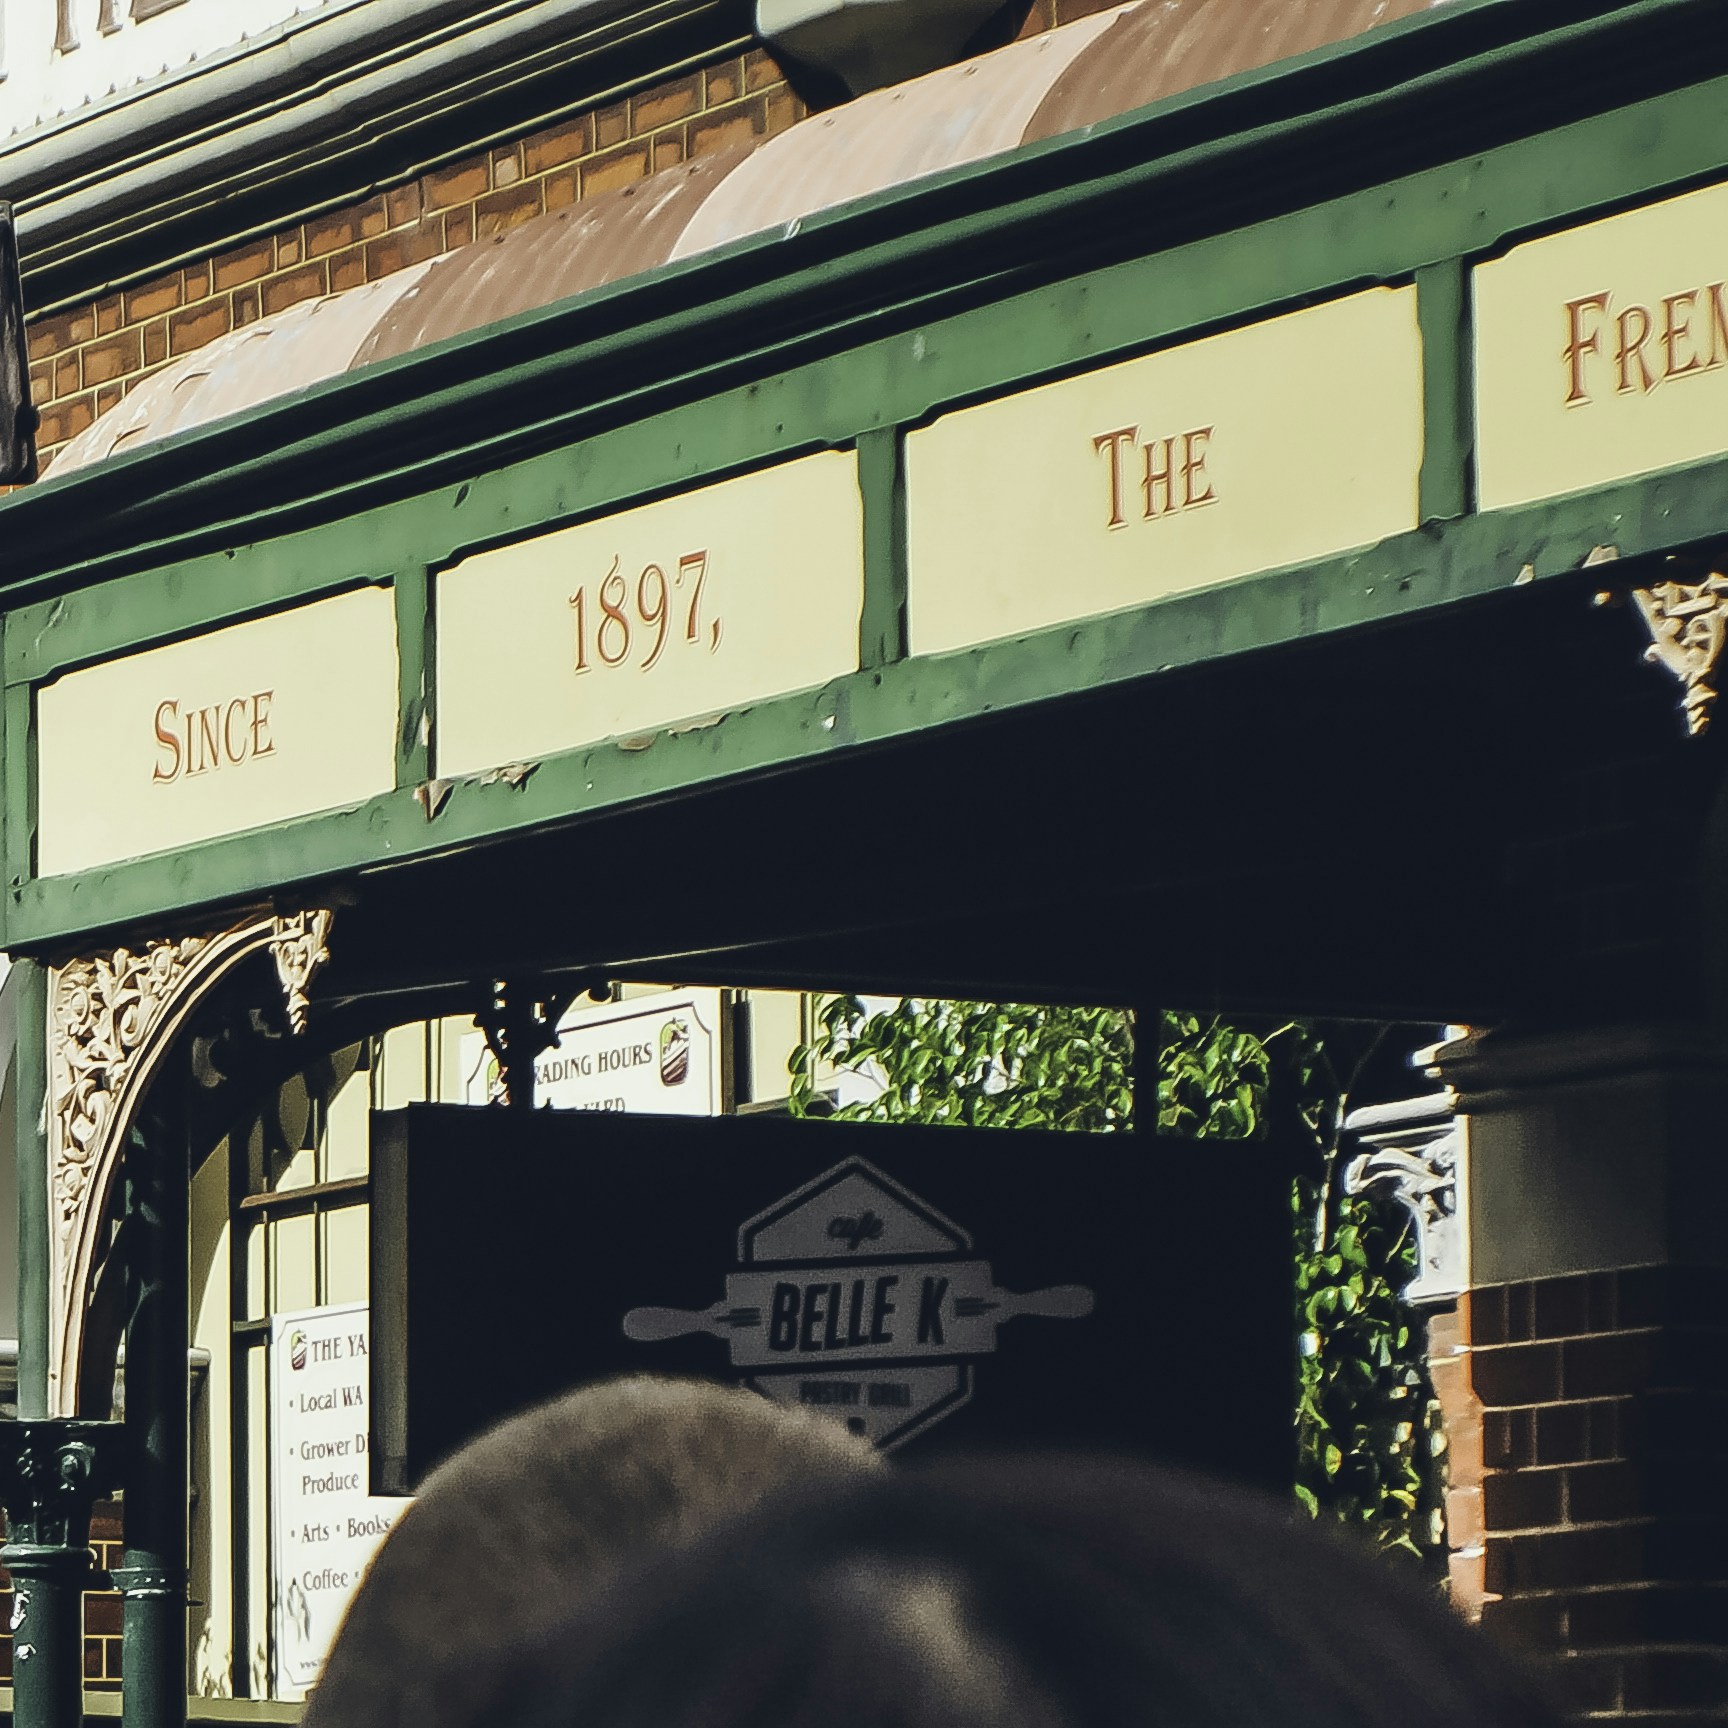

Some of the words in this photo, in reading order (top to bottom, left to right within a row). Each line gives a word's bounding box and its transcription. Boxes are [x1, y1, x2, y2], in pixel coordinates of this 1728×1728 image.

[568, 553, 723, 675] 1897,
[1092, 423, 1219, 530] THE
[598, 1041, 653, 1072] HOURS
[769, 1276, 899, 1352] BELLE
[917, 1276, 949, 1345] K
[311, 1337, 343, 1363] THE
[299, 1388, 338, 1414] Local
[342, 1385, 364, 1408] WA
[300, 1439, 352, 1461] Grower
[301, 1471, 359, 1496] Produce
[301, 1522, 330, 1543] Arts
[302, 1567, 349, 1592] Coffee
